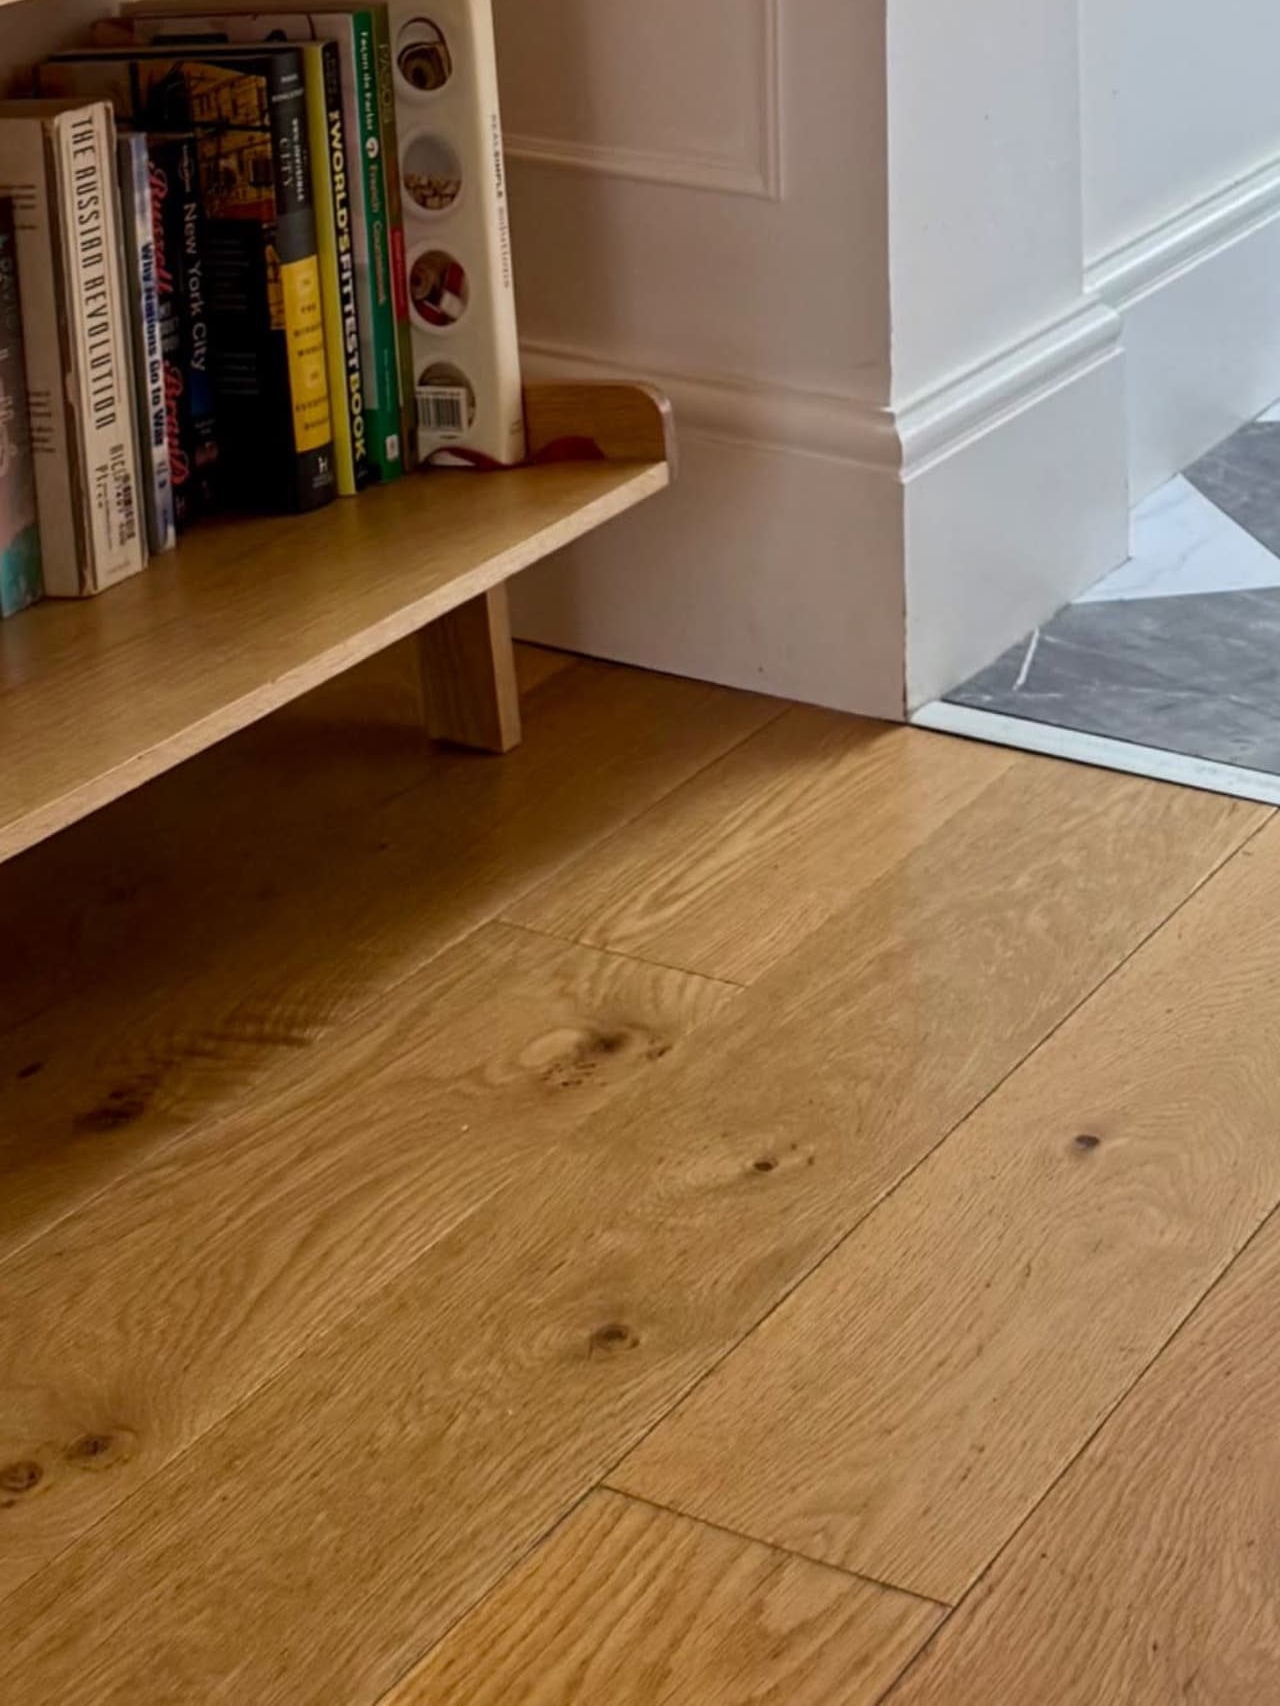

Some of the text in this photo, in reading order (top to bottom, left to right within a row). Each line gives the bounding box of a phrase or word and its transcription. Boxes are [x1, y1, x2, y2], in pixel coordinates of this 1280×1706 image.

[146, 161, 174, 295] Russell
[278, 137, 295, 189] CITY
[70, 116, 118, 433] THE RUSSIAN REVOLUTION
[141, 242, 167, 447] Why Nations Go to War
[182, 202, 208, 372] New York City
[330, 120, 368, 462] WORLD'S FITTEST BOOK
[161, 361, 190, 486] Brand
